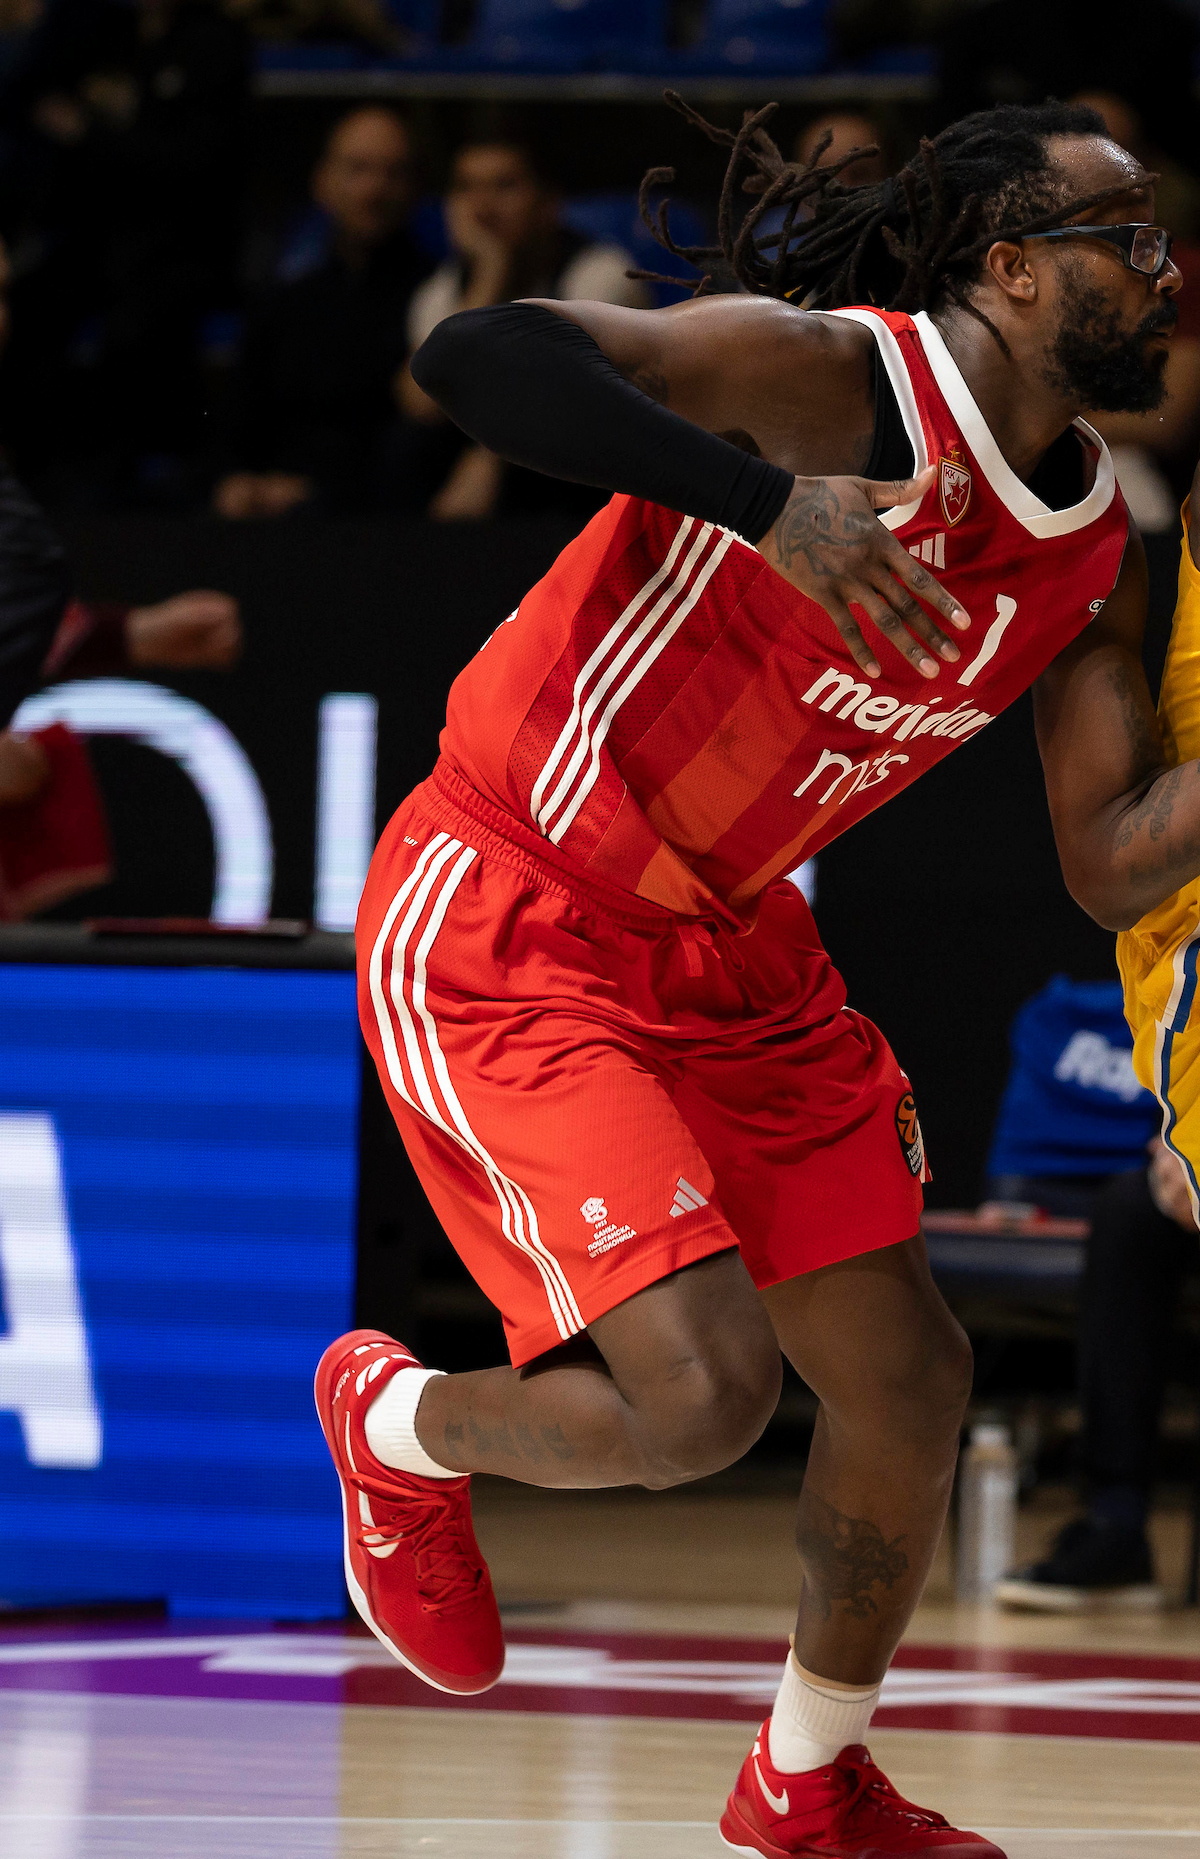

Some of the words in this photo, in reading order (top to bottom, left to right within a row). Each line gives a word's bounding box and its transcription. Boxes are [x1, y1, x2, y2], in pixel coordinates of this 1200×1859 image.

[945, 467, 956, 480] KK
[957, 592, 1018, 687] 1
[792, 747, 910, 806] mts
[593, 1223, 618, 1241] БАНКА
